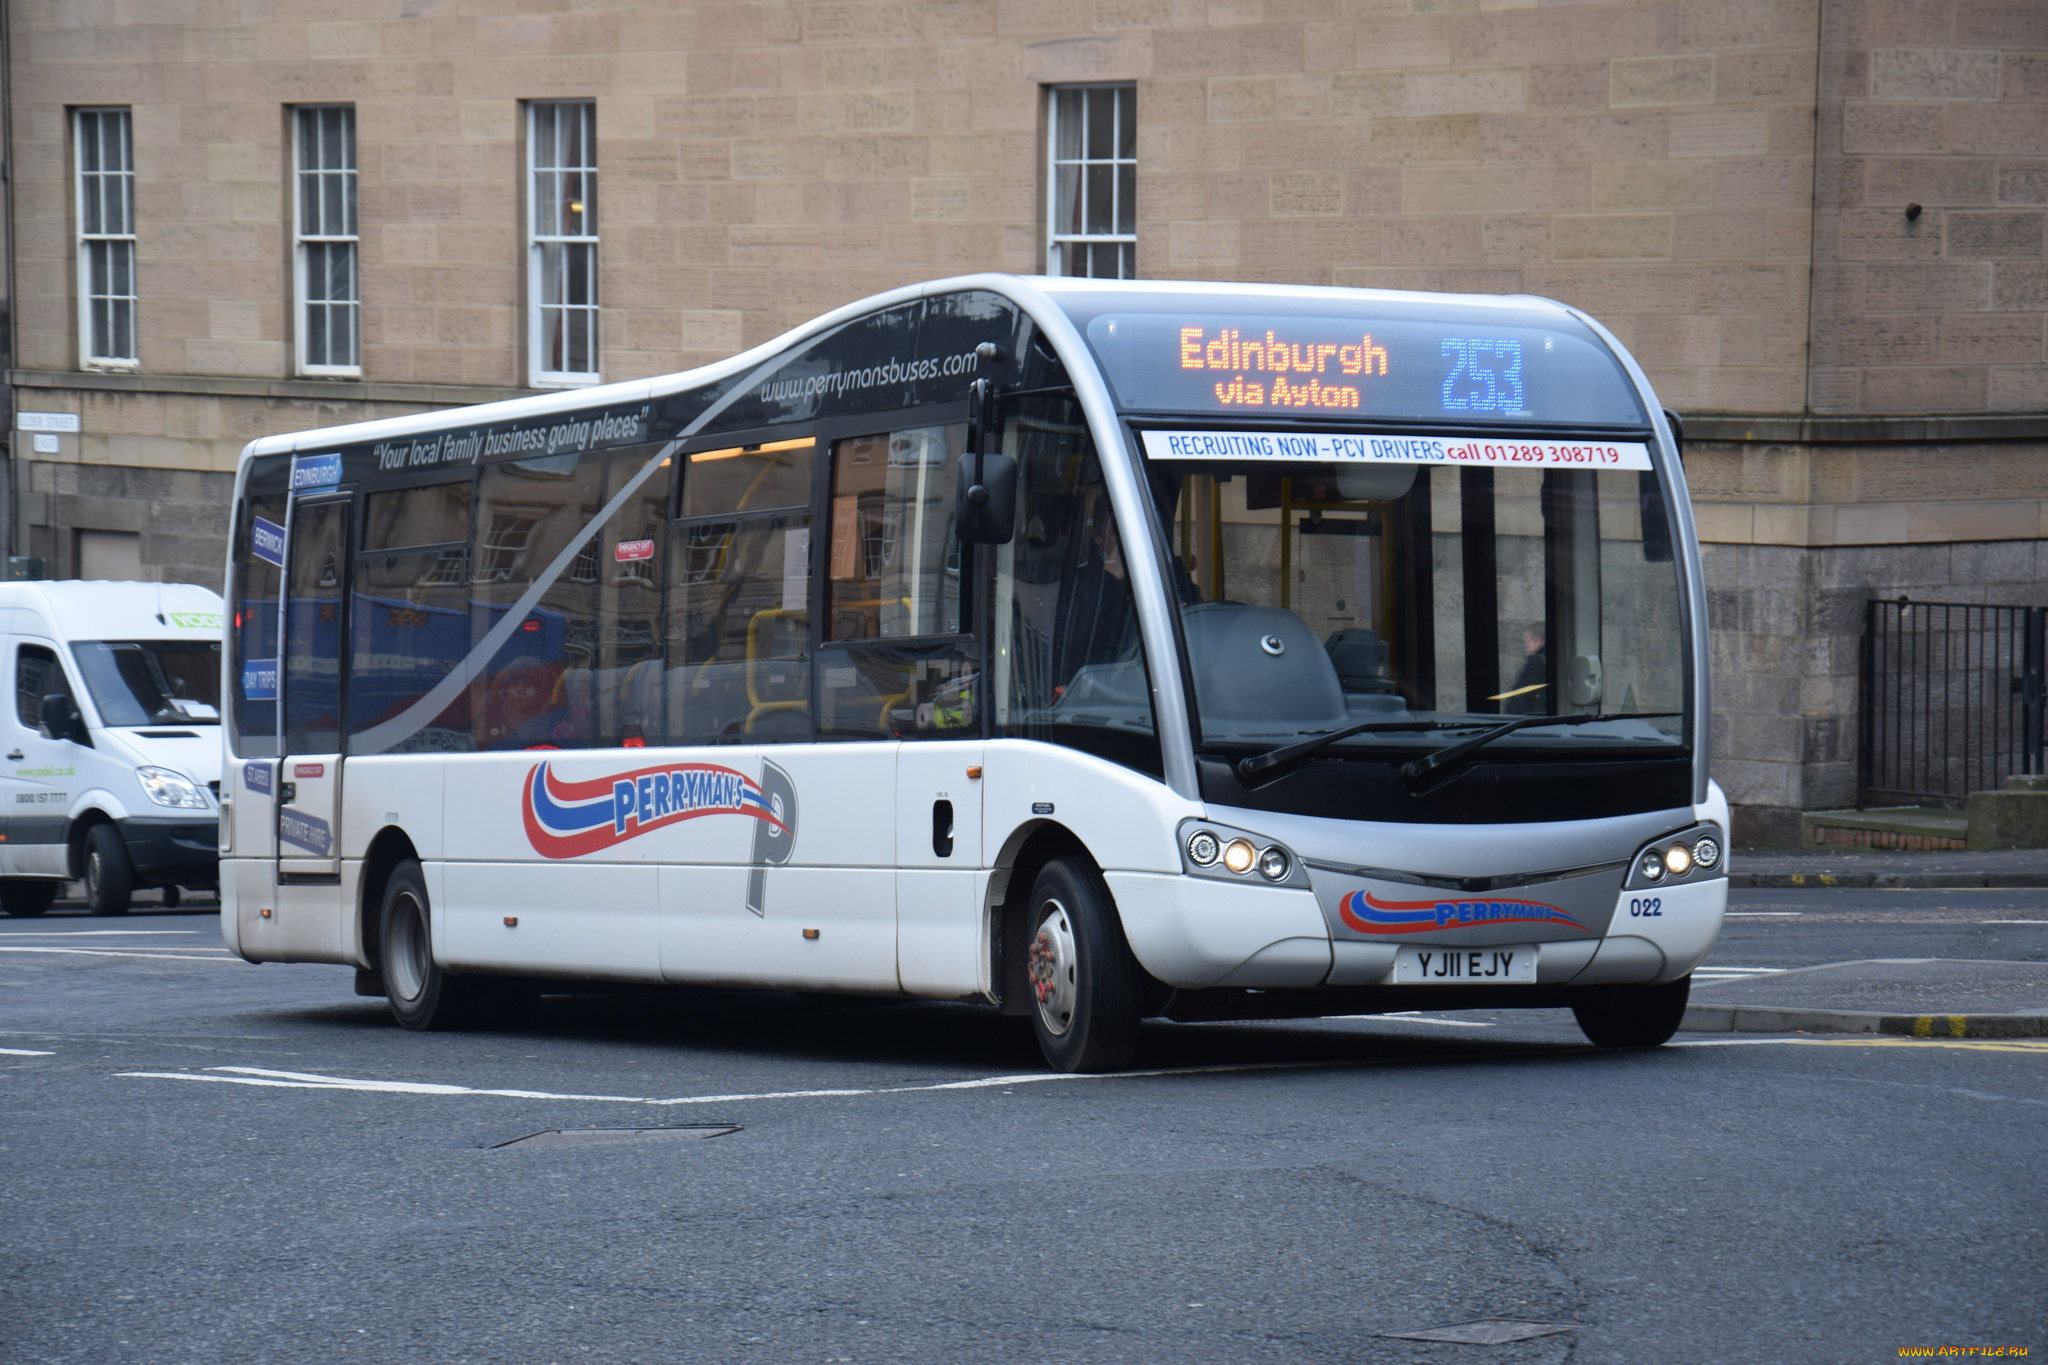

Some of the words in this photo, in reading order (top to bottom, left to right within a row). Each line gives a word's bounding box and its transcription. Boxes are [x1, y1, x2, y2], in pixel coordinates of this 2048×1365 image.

[1180, 327, 1388, 376] Edinburgh
[761, 351, 979, 403] www.perrymansbuses.com
[1440, 337, 1524, 411] 253
[1215, 375, 1264, 405] via
[1271, 377, 1360, 408] Ayton
[47, 416, 74, 428] STREET
[408, 435, 440, 467] local
[442, 430, 483, 465] family
[484, 424, 546, 456] business
[547, 416, 590, 455] going
[1168, 435, 1273, 456] RECRUITING
[1371, 438, 1445, 461] DRIVERS
[1447, 443, 1481, 460] call
[1484, 444, 1545, 462] 01289
[1550, 445, 1620, 463] 308719
[294, 464, 338, 487] EDINBURGH
[254, 526, 283, 555] BERWICK
[245, 671, 257, 689] DAY
[258, 670, 276, 689] TRIPS
[280, 815, 309, 842] PRIVATE
[309, 824, 326, 849] HIRE
[1630, 897, 1663, 917] 022
[1418, 952, 1461, 977] YJ11
[1468, 952, 1514, 977] EJY
